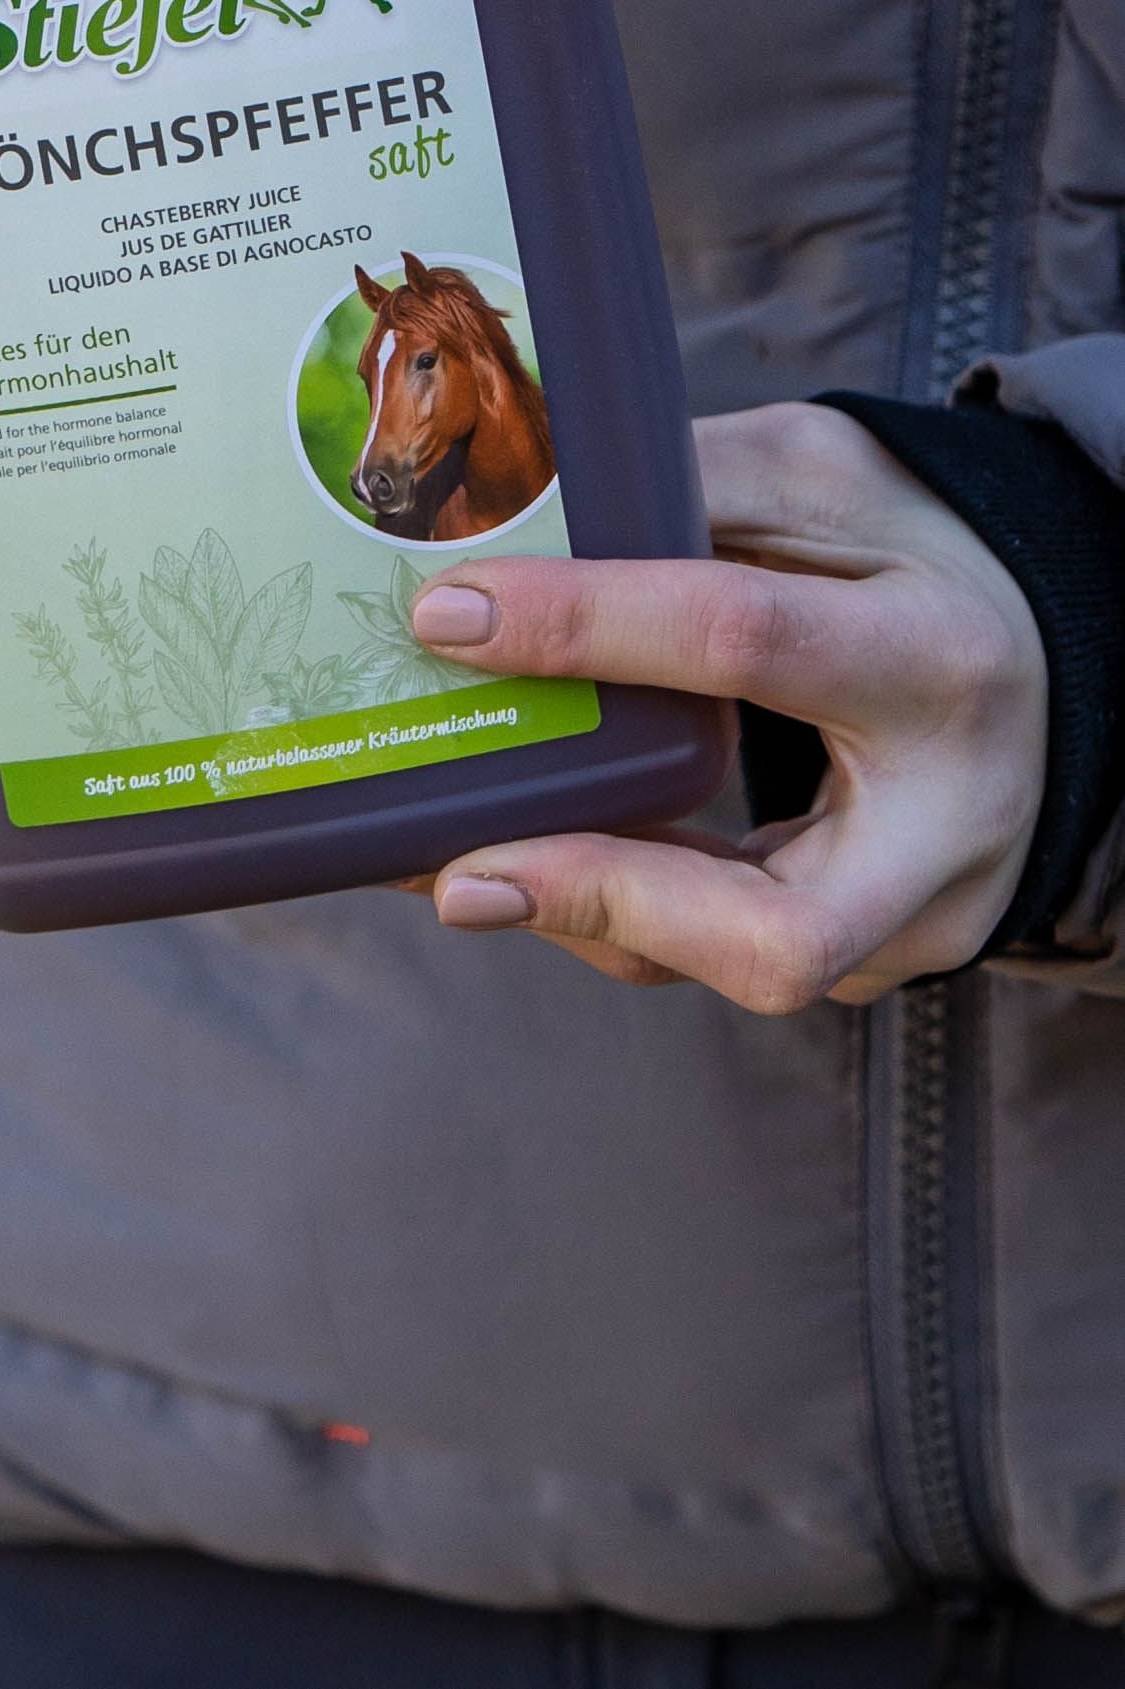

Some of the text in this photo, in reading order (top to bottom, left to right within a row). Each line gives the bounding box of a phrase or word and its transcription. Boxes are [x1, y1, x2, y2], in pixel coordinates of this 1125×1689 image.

[369, 125, 455, 180] saft
[101, 185, 301, 234] CHASTEBERRY JUICE
[120, 213, 292, 258] JUS DE GATTILIER
[48, 224, 373, 294] LIQUIDO A BASE DI AGNOCASTO
[33, 329, 74, 356] für
[81, 323, 131, 350] den
[6, 425, 24, 439] for
[28, 423, 50, 437] the
[53, 416, 112, 432] hormone
[116, 405, 167, 423] balance
[17, 442, 46, 459] pour
[119, 421, 183, 442] hormonal
[17, 463, 38, 478] per
[114, 442, 177, 462] ormonale
[84, 707, 518, 796] Saft aus 100 % naturbelassener Kräutermischung
